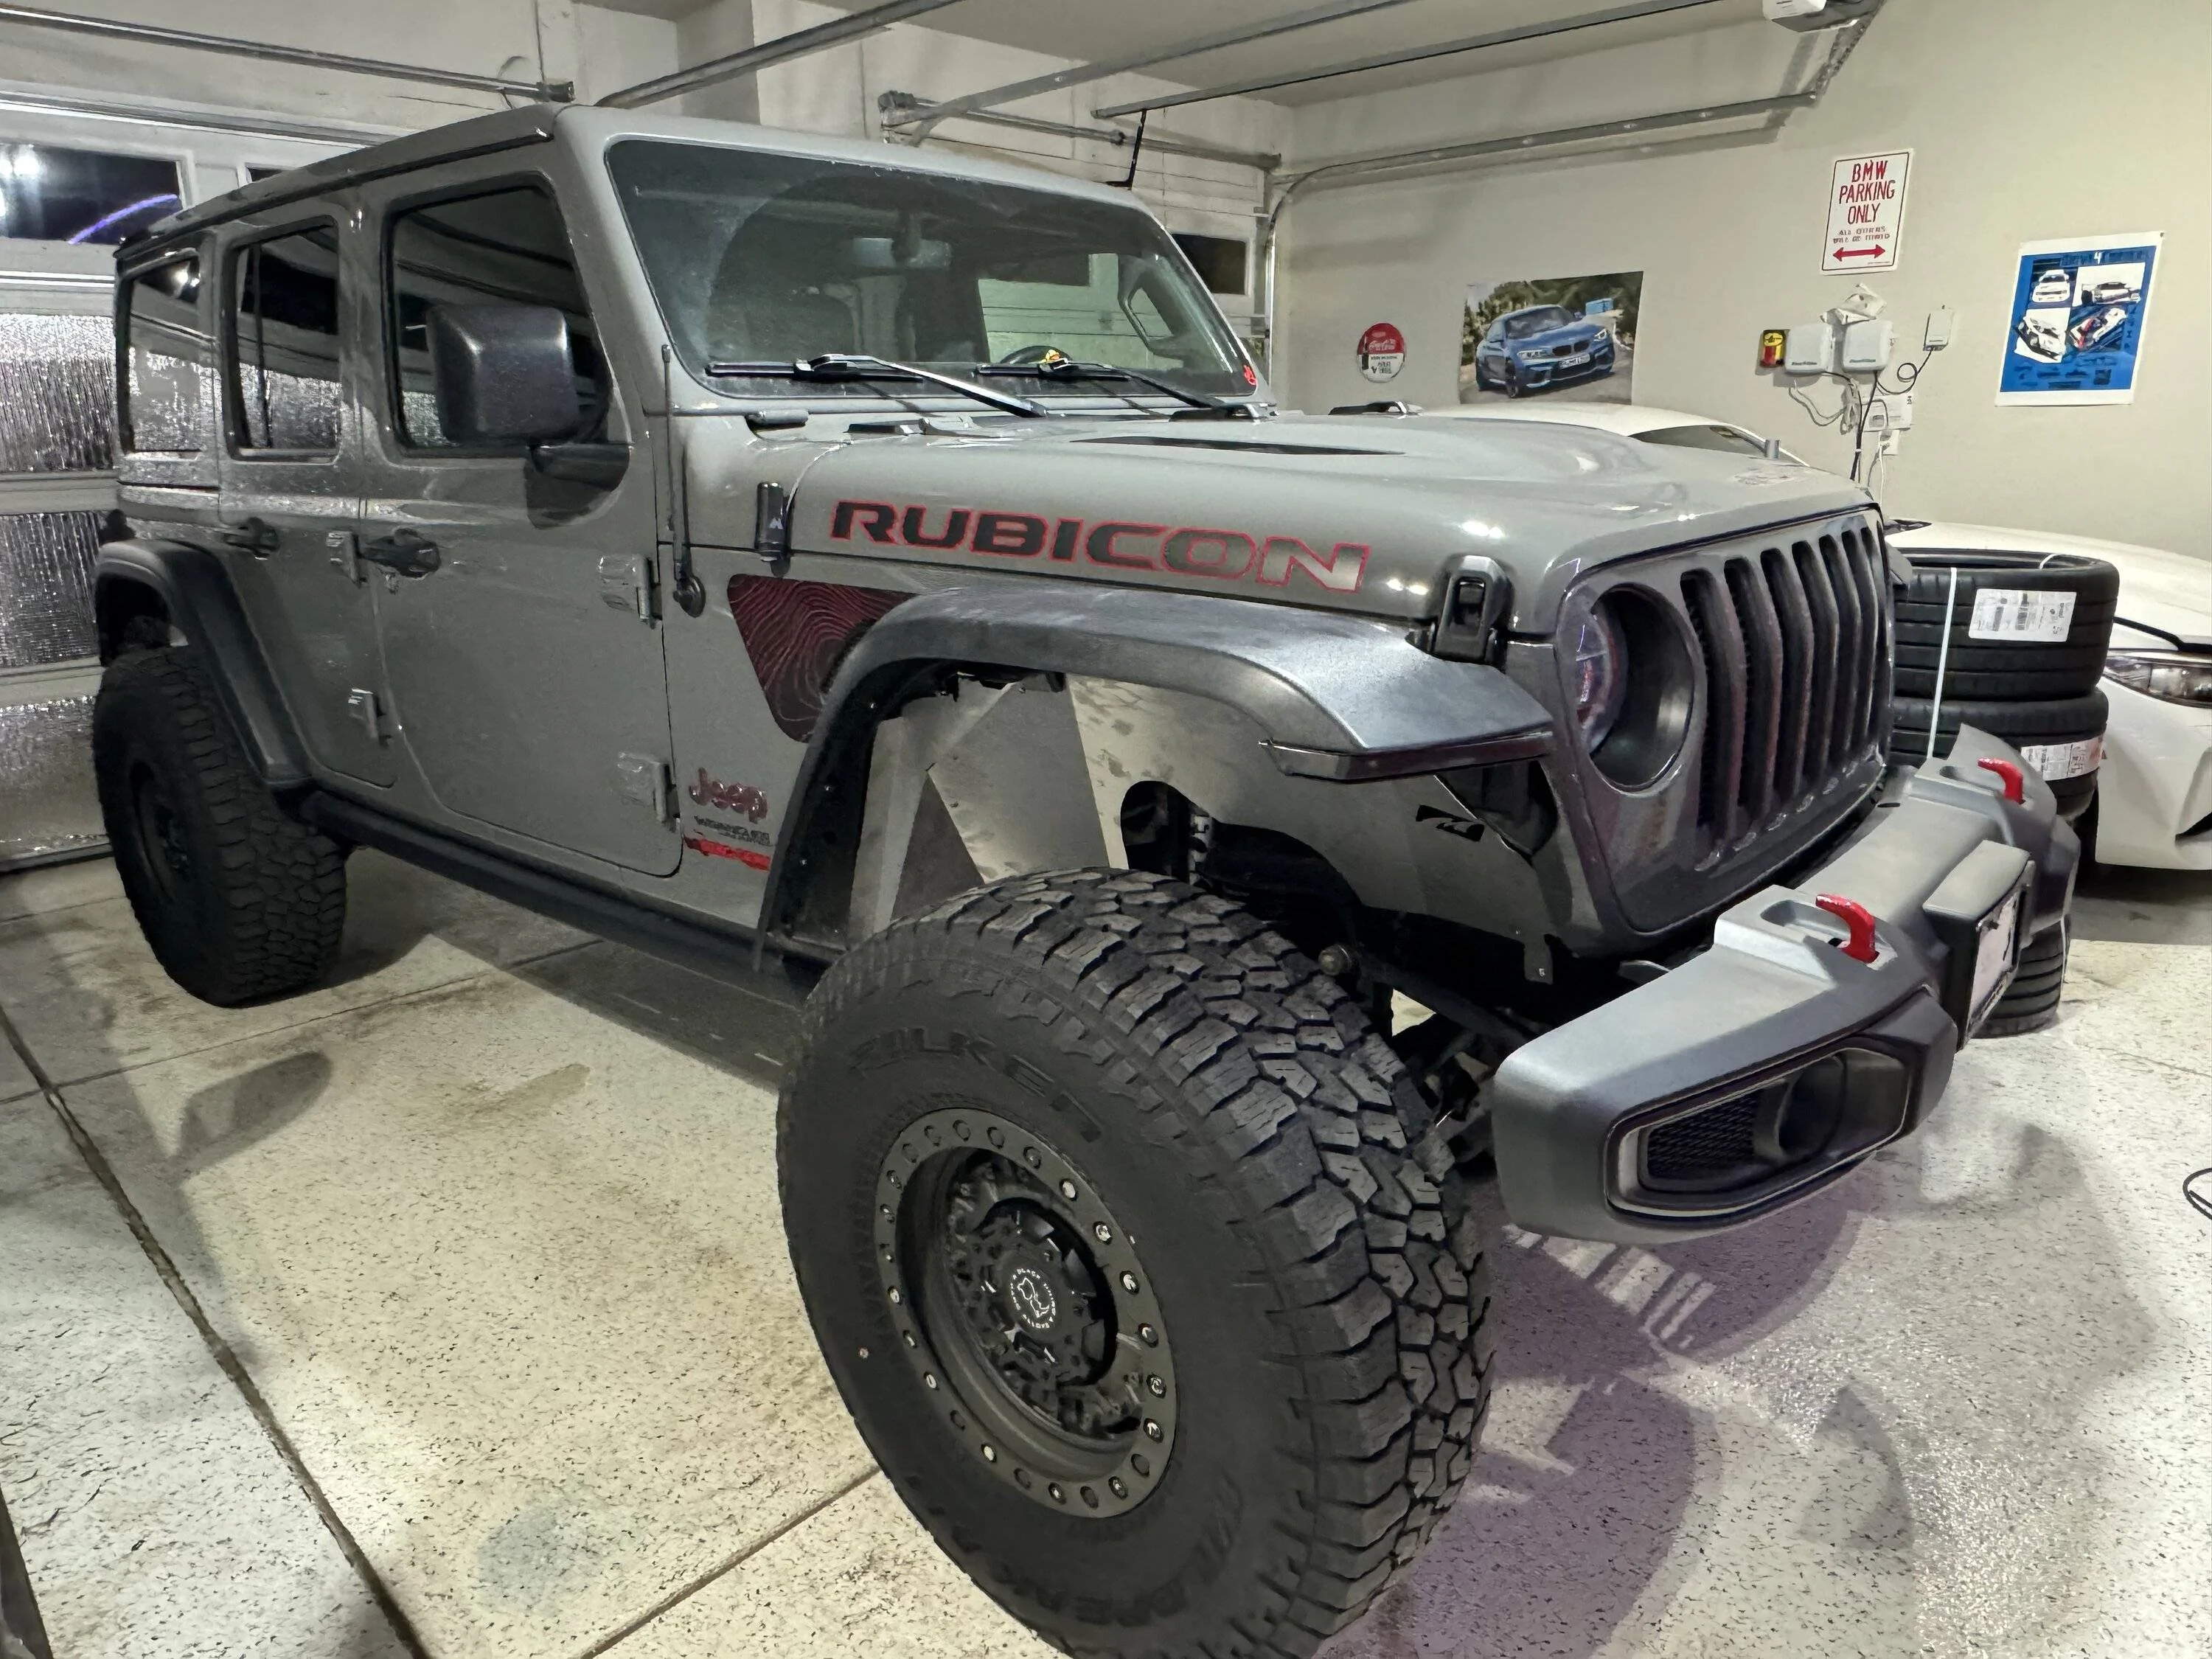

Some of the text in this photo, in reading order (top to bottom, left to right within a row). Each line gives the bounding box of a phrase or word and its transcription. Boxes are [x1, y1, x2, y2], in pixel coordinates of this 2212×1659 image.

[1851, 159, 1888, 182] BMW
[1839, 180, 1896, 204] PARKING
[1848, 203, 1881, 224] ONLY
[830, 499, 1371, 593] RUBICON
[689, 767, 768, 824] Jeep
